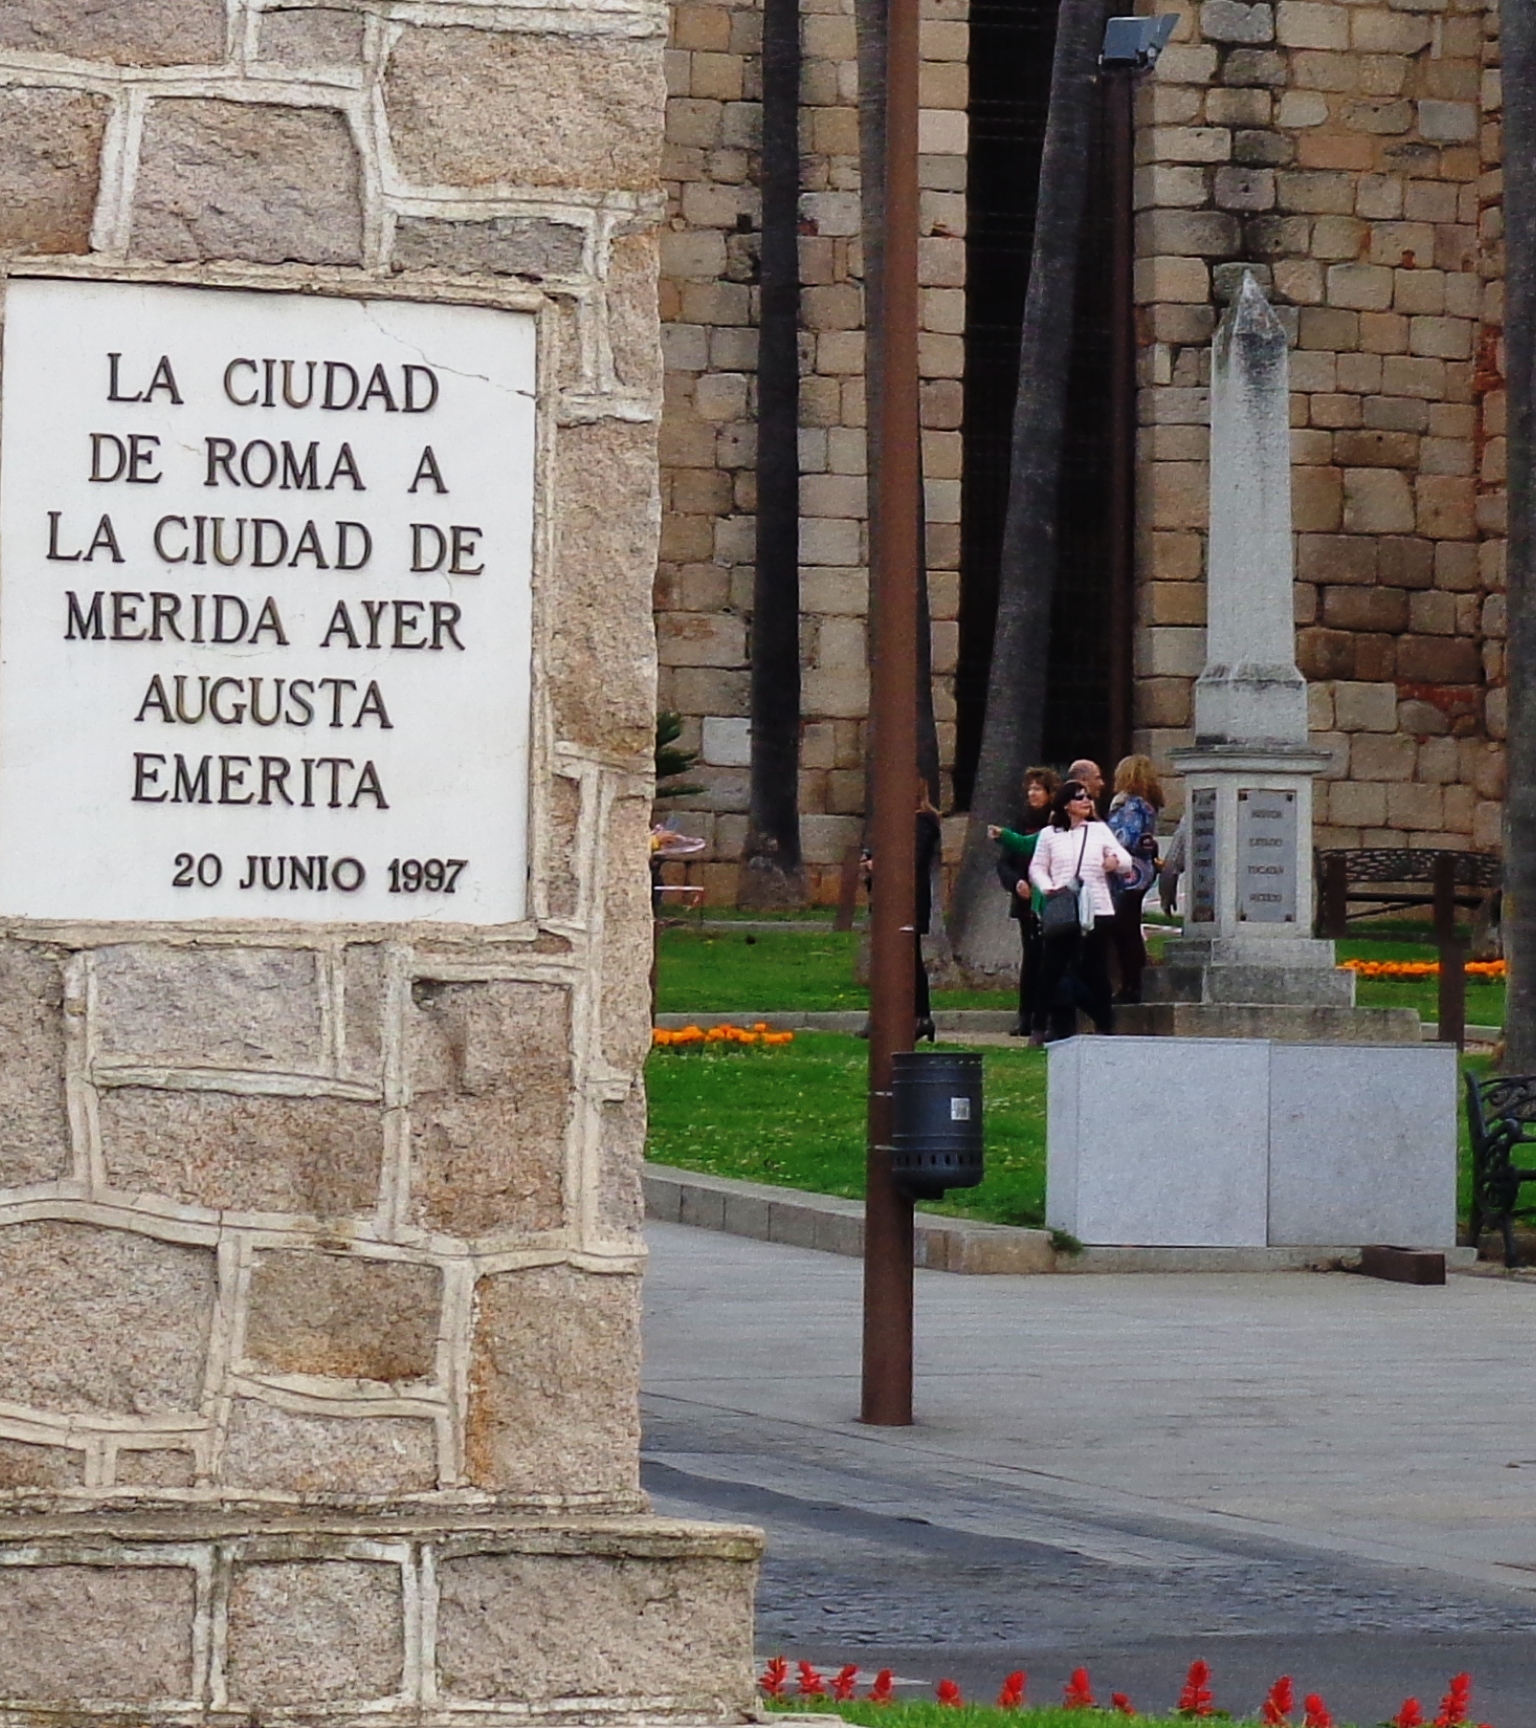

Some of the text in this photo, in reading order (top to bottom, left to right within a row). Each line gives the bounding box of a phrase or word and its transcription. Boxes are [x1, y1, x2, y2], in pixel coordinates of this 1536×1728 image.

[106, 352, 439, 414] LA CIUDAD
[87, 432, 450, 495] DE ROMA A
[46, 511, 485, 576] LA CIUDAD DE
[63, 590, 466, 651] MERIDA AYER
[133, 673, 394, 730] AUGUSTA
[130, 752, 390, 810] EMERITA
[171, 852, 469, 894] 20 JUNIO 1997
